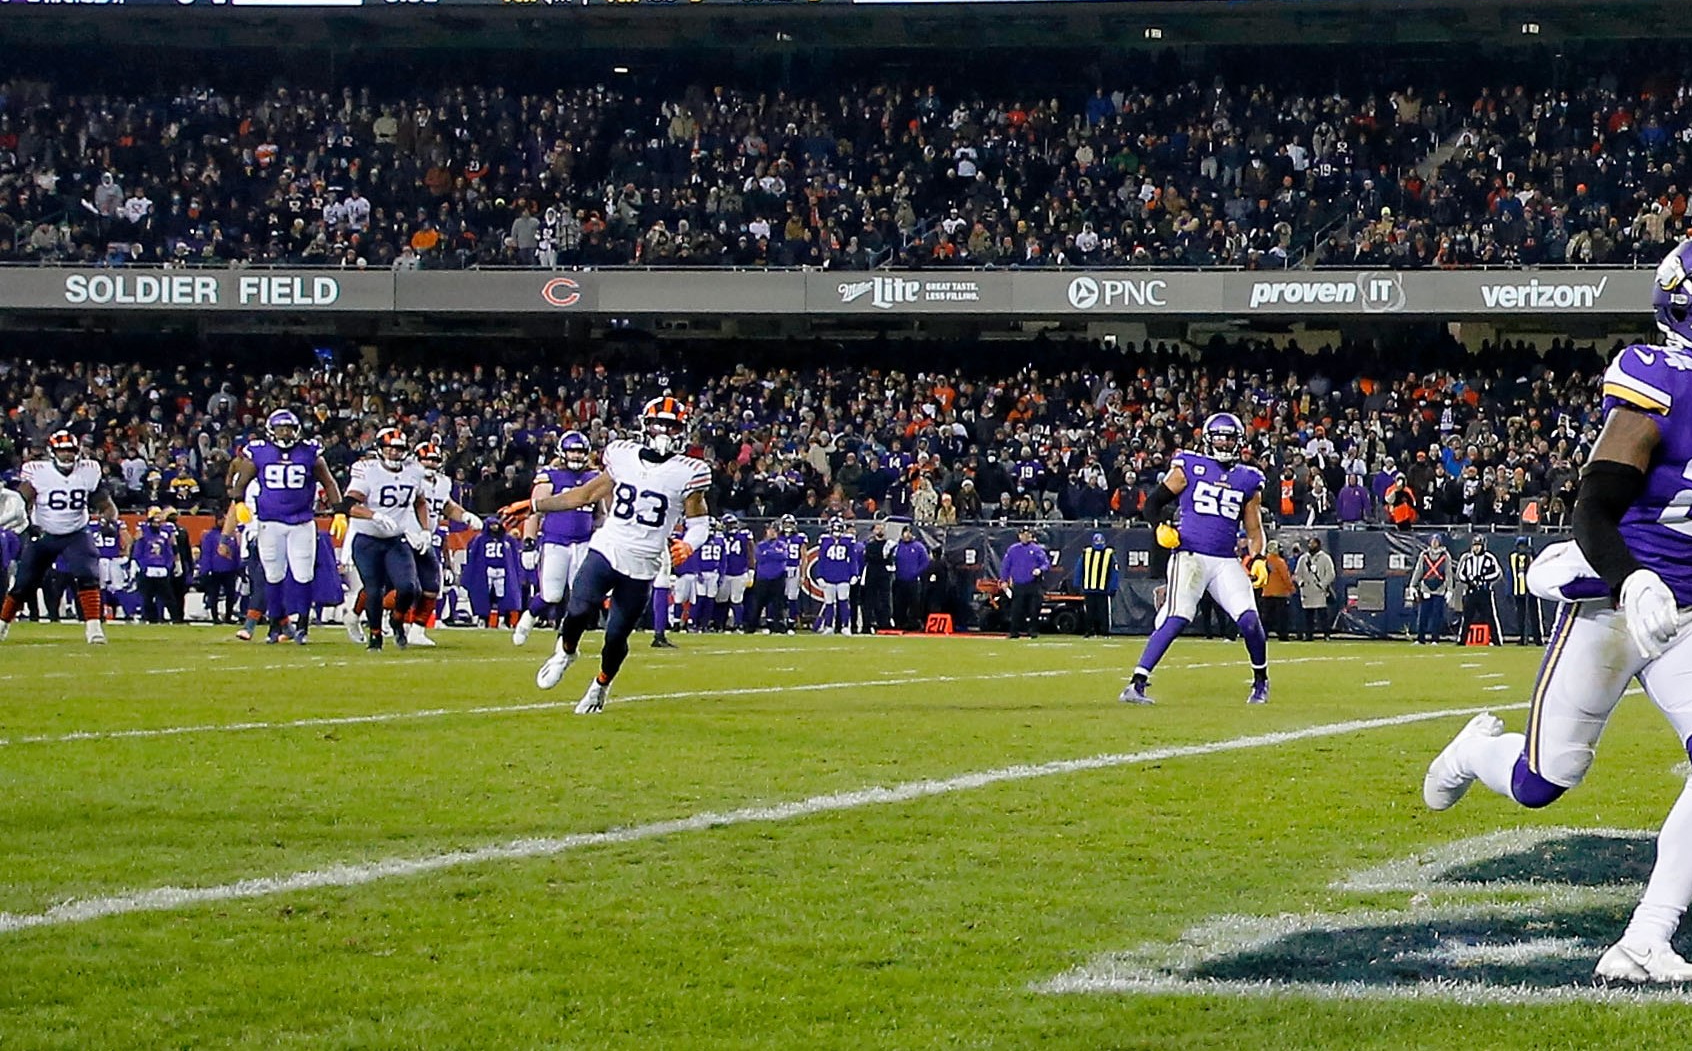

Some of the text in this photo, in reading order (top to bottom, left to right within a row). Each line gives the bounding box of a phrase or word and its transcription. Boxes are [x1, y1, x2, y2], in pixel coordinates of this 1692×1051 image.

[64, 275, 339, 305] SOLDIER FIELD
[872, 277, 921, 309] Lite
[1103, 280, 1167, 306] PNC
[1250, 280, 1393, 309] proven IT
[1481, 279, 1597, 308] verizon
[265, 464, 306, 489] 96
[1021, 466, 1033, 479] 19
[48, 490, 87, 511] 68
[380, 485, 415, 508] 67
[614, 482, 668, 528] 83
[1192, 480, 1244, 521] 55
[1522, 501, 1539, 524] 4
[826, 545, 846, 560] 48
[1128, 551, 1150, 567] 34
[927, 617, 947, 633] 20
[1468, 627, 1486, 643] 10
